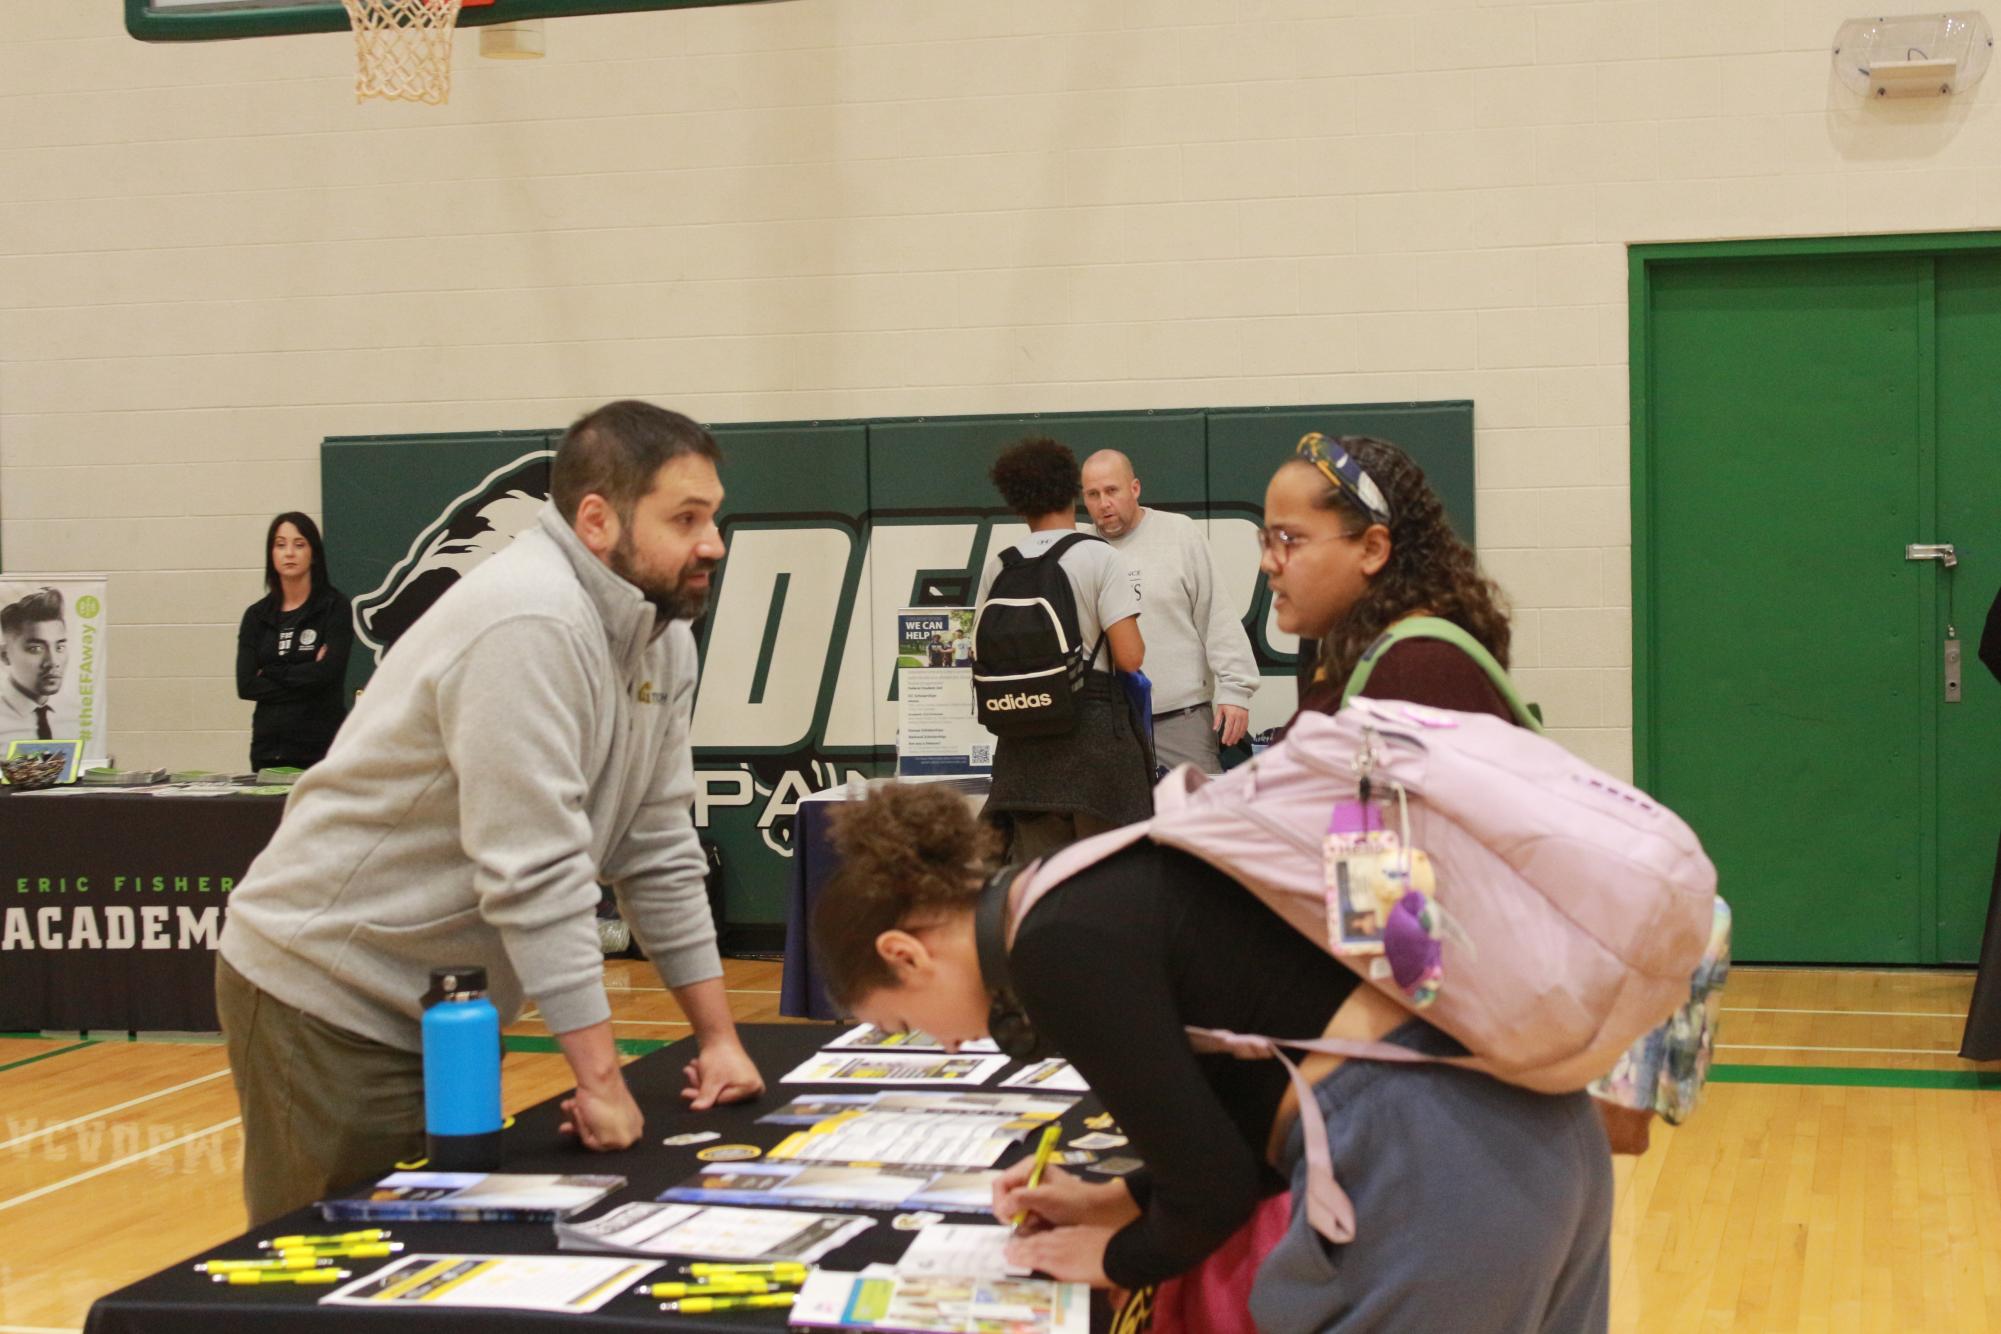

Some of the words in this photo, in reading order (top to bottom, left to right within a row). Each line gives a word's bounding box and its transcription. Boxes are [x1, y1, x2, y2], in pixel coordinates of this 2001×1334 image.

[905, 621, 921, 630] WE
[922, 621, 943, 630] CAN
[905, 631, 930, 640] HELP
[79, 624, 96, 741] #theEFAway
[986, 692, 1052, 711] adidas
[17, 878, 88, 893] ERIC
[114, 877, 233, 893] FISHER
[1, 906, 230, 950] ACADEM
